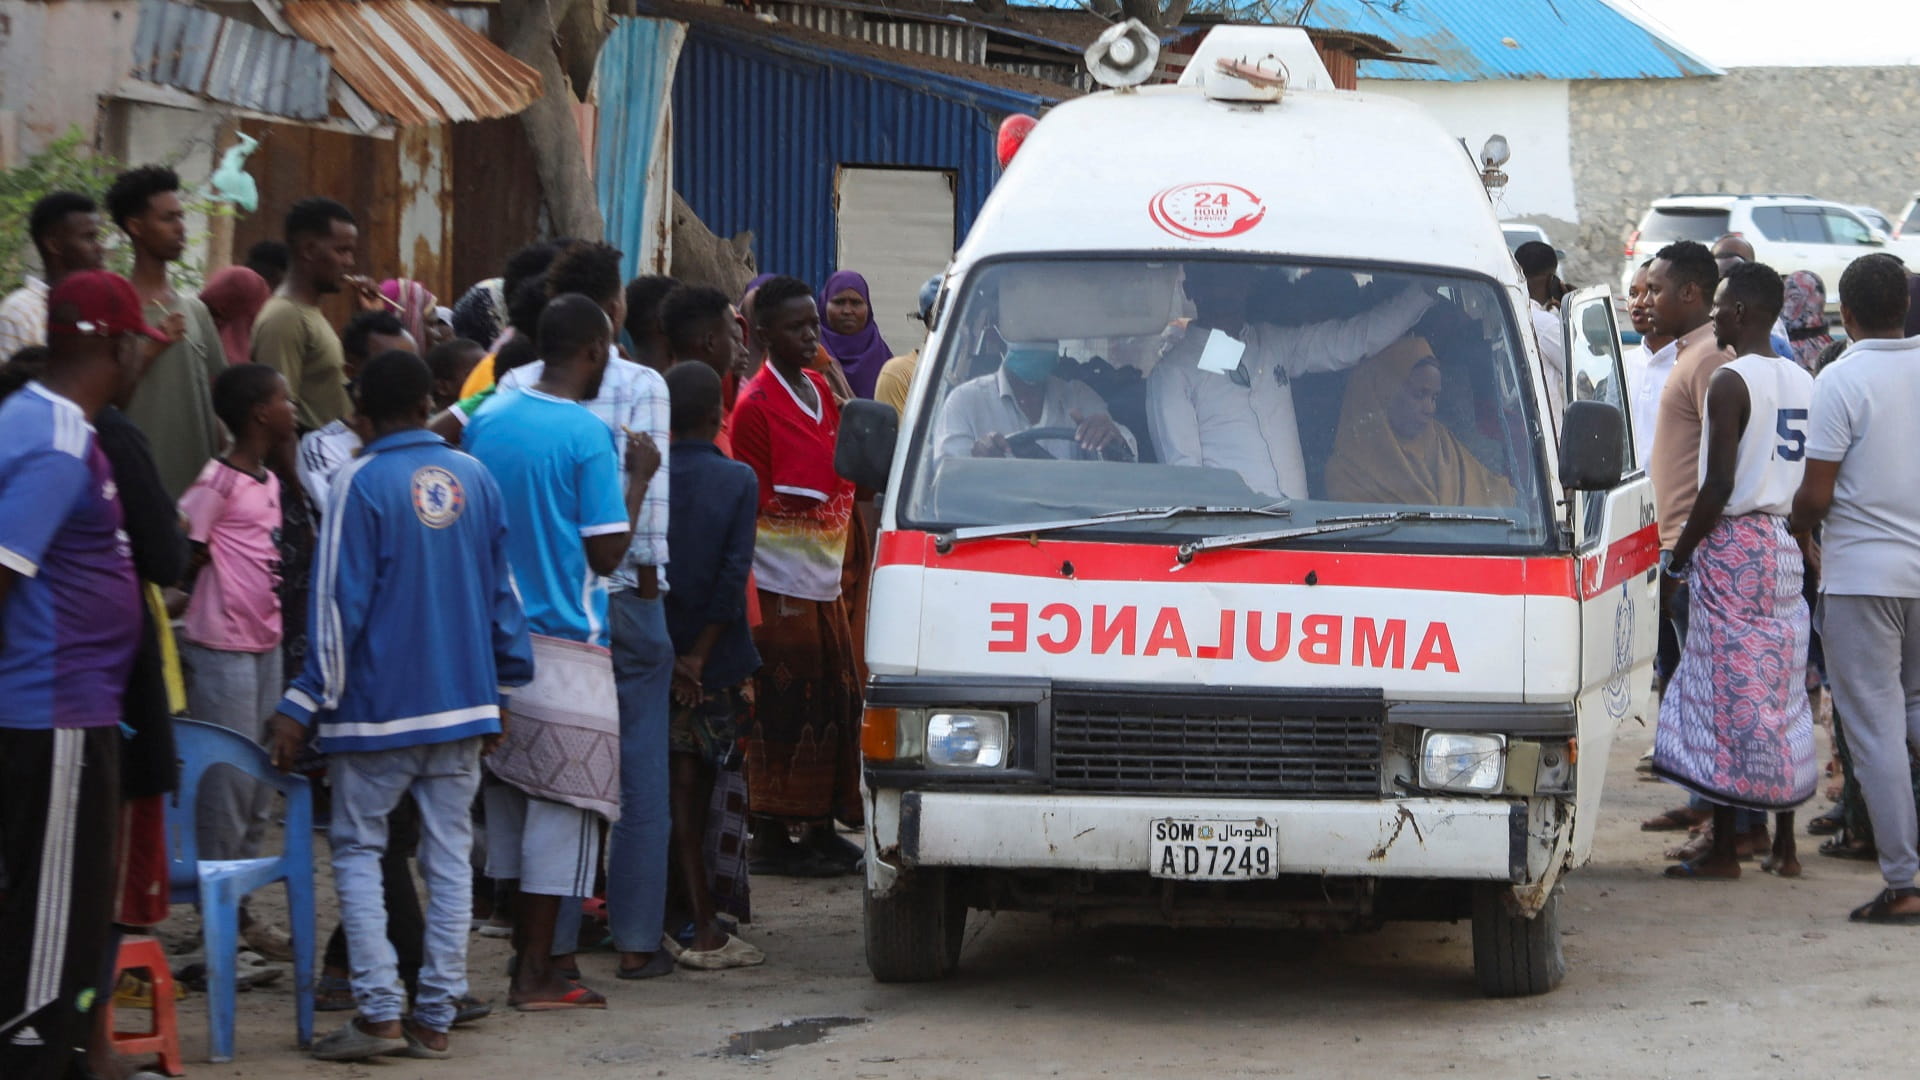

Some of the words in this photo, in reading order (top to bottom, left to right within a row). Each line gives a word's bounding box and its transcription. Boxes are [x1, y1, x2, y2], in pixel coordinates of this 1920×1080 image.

[1194, 192, 1229, 207] 24
[1194, 208, 1228, 216] HOUR
[1156, 823, 1194, 841] SOM
[1218, 823, 1272, 842] الصومال
[1160, 845, 1270, 876] AD7249
